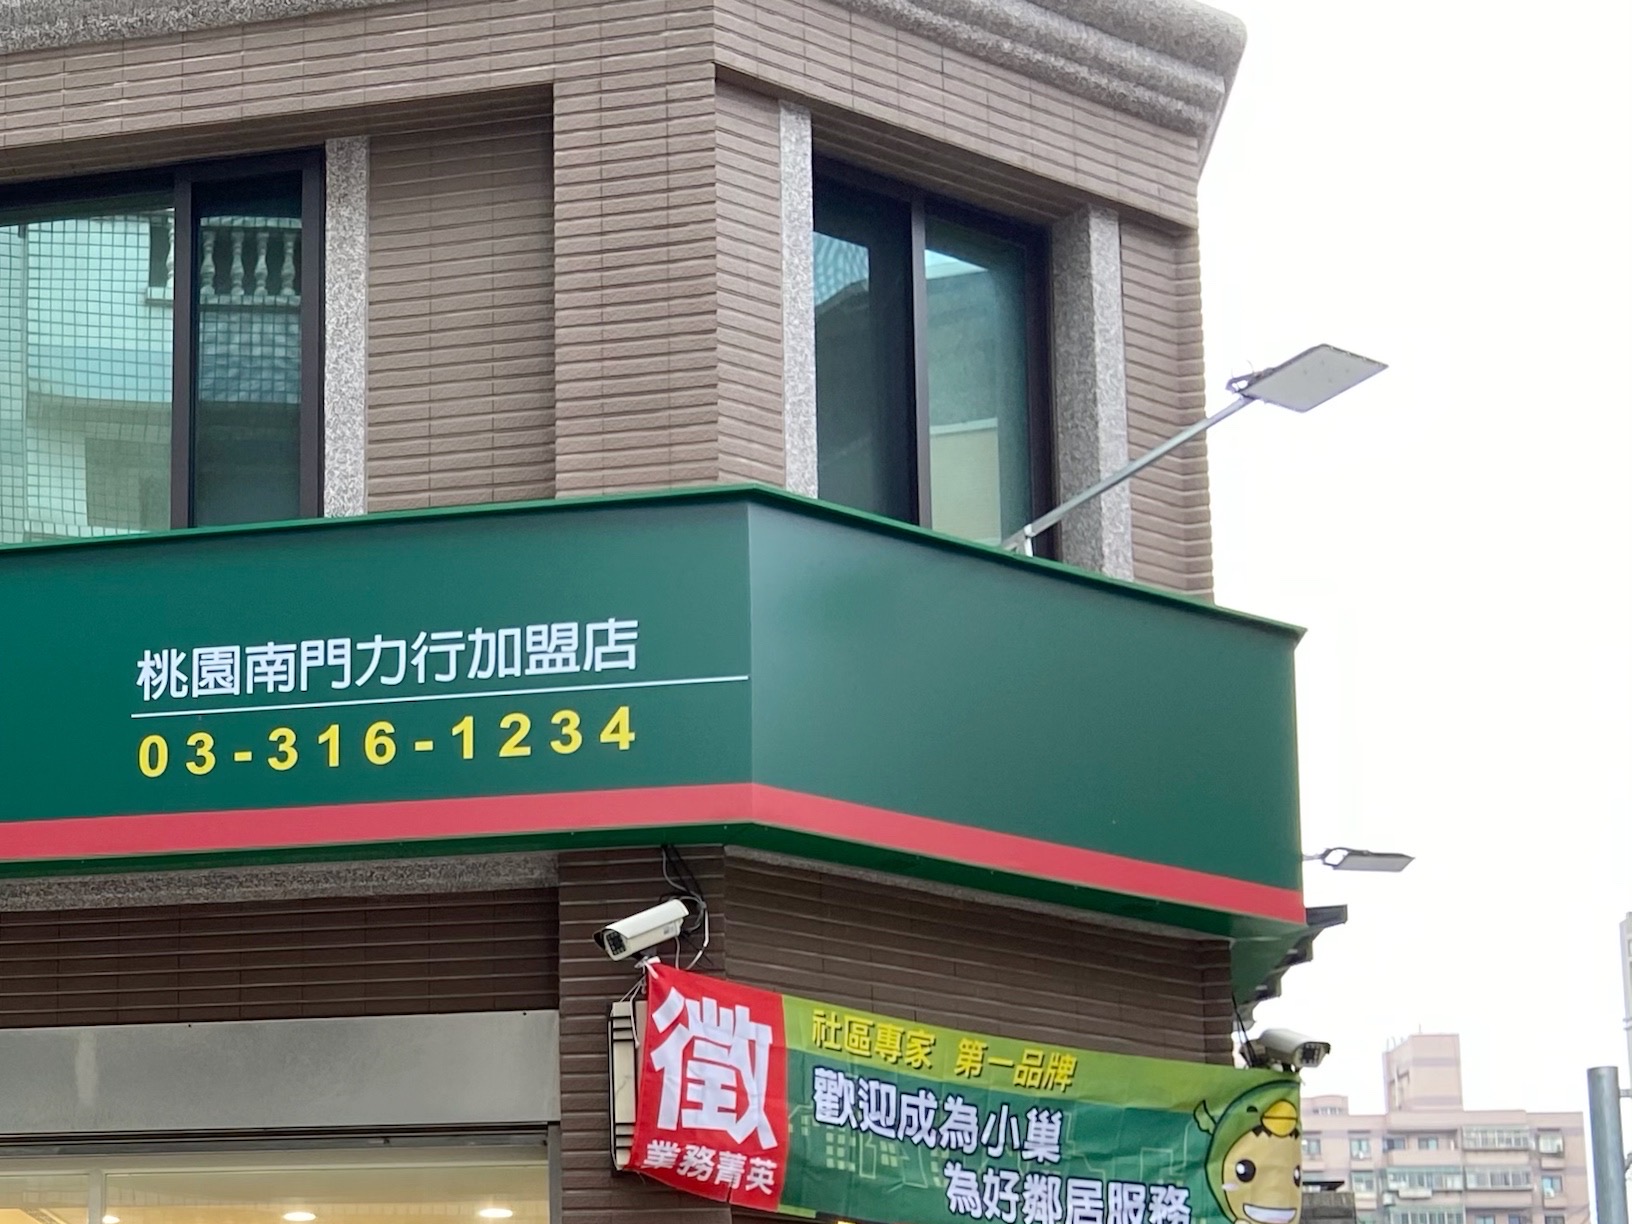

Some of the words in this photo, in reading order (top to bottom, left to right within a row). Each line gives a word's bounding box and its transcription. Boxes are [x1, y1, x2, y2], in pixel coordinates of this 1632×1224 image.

[136, 618, 639, 701] 桃園南門力行加盟店
[138, 707, 635, 778] 03-316-1234
[650, 986, 779, 1150] 徵
[812, 1009, 936, 1070] 社區專家
[956, 1036, 1077, 1093] 第一品牌
[812, 1067, 1063, 1164] 歡迎成為小巢
[641, 1139, 778, 1195] 業務菁英
